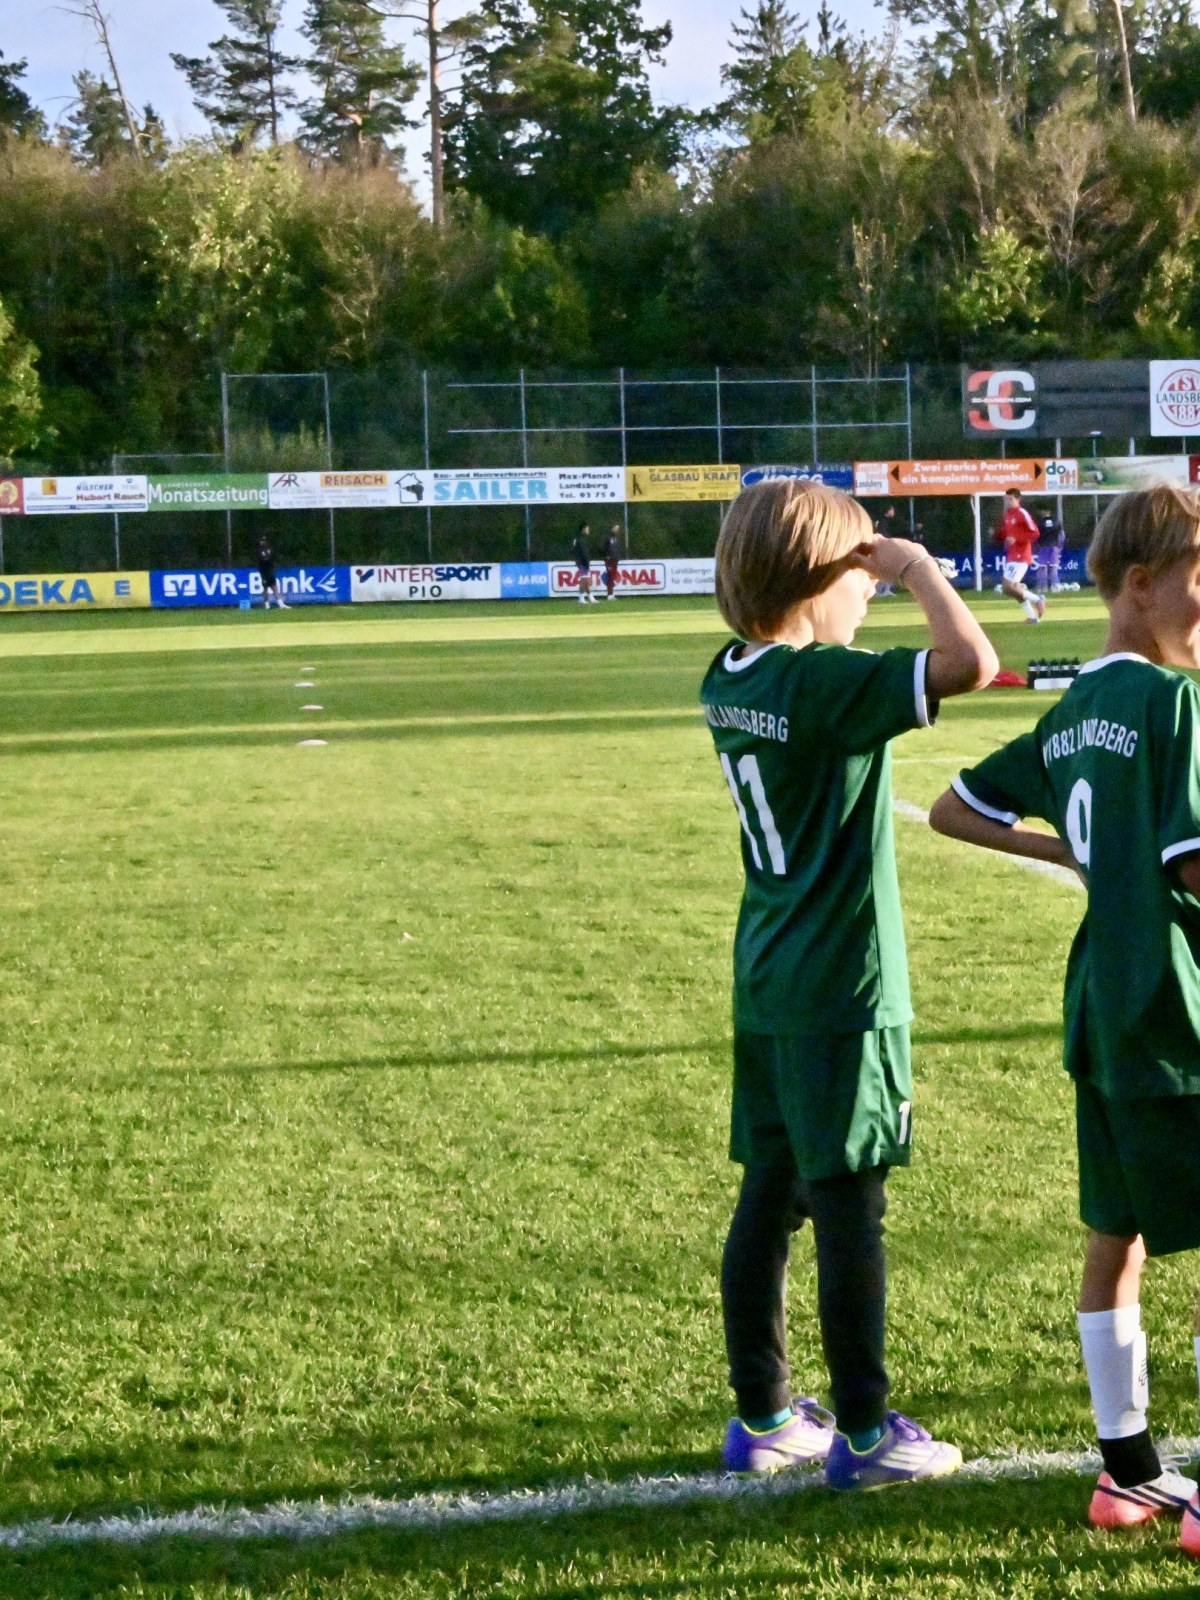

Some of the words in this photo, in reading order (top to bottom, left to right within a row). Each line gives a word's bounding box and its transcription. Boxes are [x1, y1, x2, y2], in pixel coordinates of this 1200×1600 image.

[914, 462, 941, 473] Zwei
[945, 462, 978, 472] starke
[980, 461, 1020, 471] Partner
[1046, 461, 1066, 475] do
[324, 475, 384, 487] REISACH
[649, 473, 700, 482] GLASBAU
[703, 472, 740, 481] KRAFT
[901, 474, 918, 483] ein
[921, 473, 981, 485] komplettes
[983, 472, 1033, 484] Angebot.
[434, 479, 549, 501] SAILER
[559, 483, 609, 491] Landsberg
[148, 483, 269, 506] Monatszeitung
[378, 566, 492, 583] INTERSPORT
[114, 580, 131, 596] E
[409, 586, 442, 598] PIO
[720, 752, 787, 875] 11
